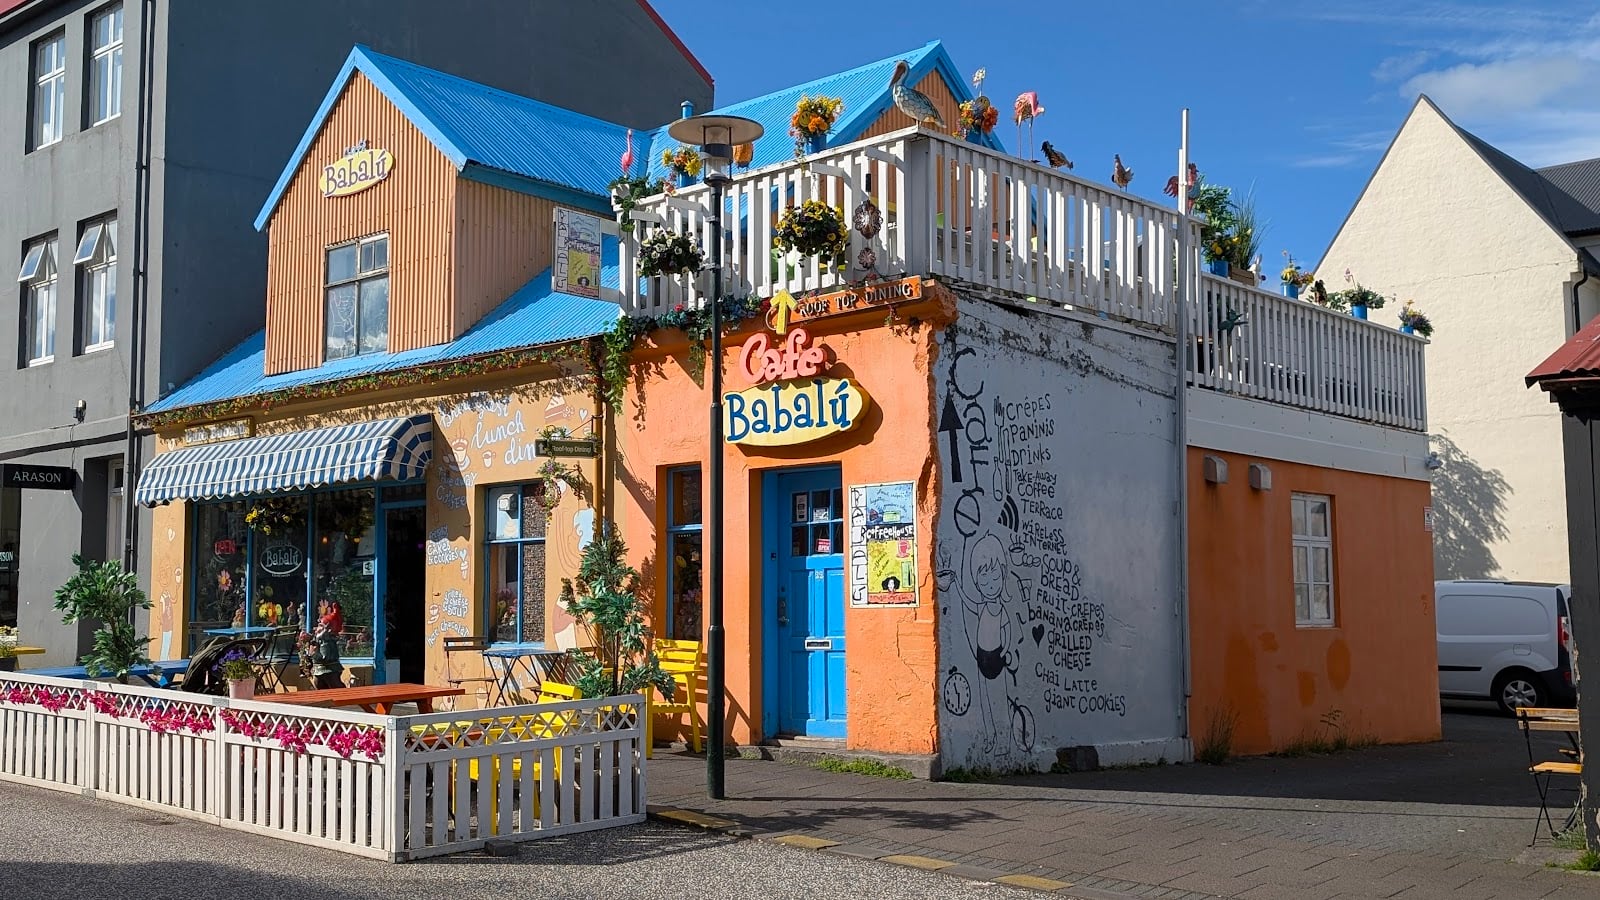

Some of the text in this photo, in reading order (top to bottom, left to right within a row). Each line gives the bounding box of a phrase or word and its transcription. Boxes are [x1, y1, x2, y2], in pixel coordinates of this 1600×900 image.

[325, 151, 387, 196] Babalú
[799, 282, 911, 316] ROOF TOP DINING
[739, 328, 824, 384] Cafe
[725, 379, 851, 441] Babalú
[471, 410, 527, 449] lunch
[13, 471, 62, 483] ARASON
[265, 548, 299, 568] Babalú
[1072, 564, 1081, 587] &
[1053, 651, 1092, 671] CHEESE
